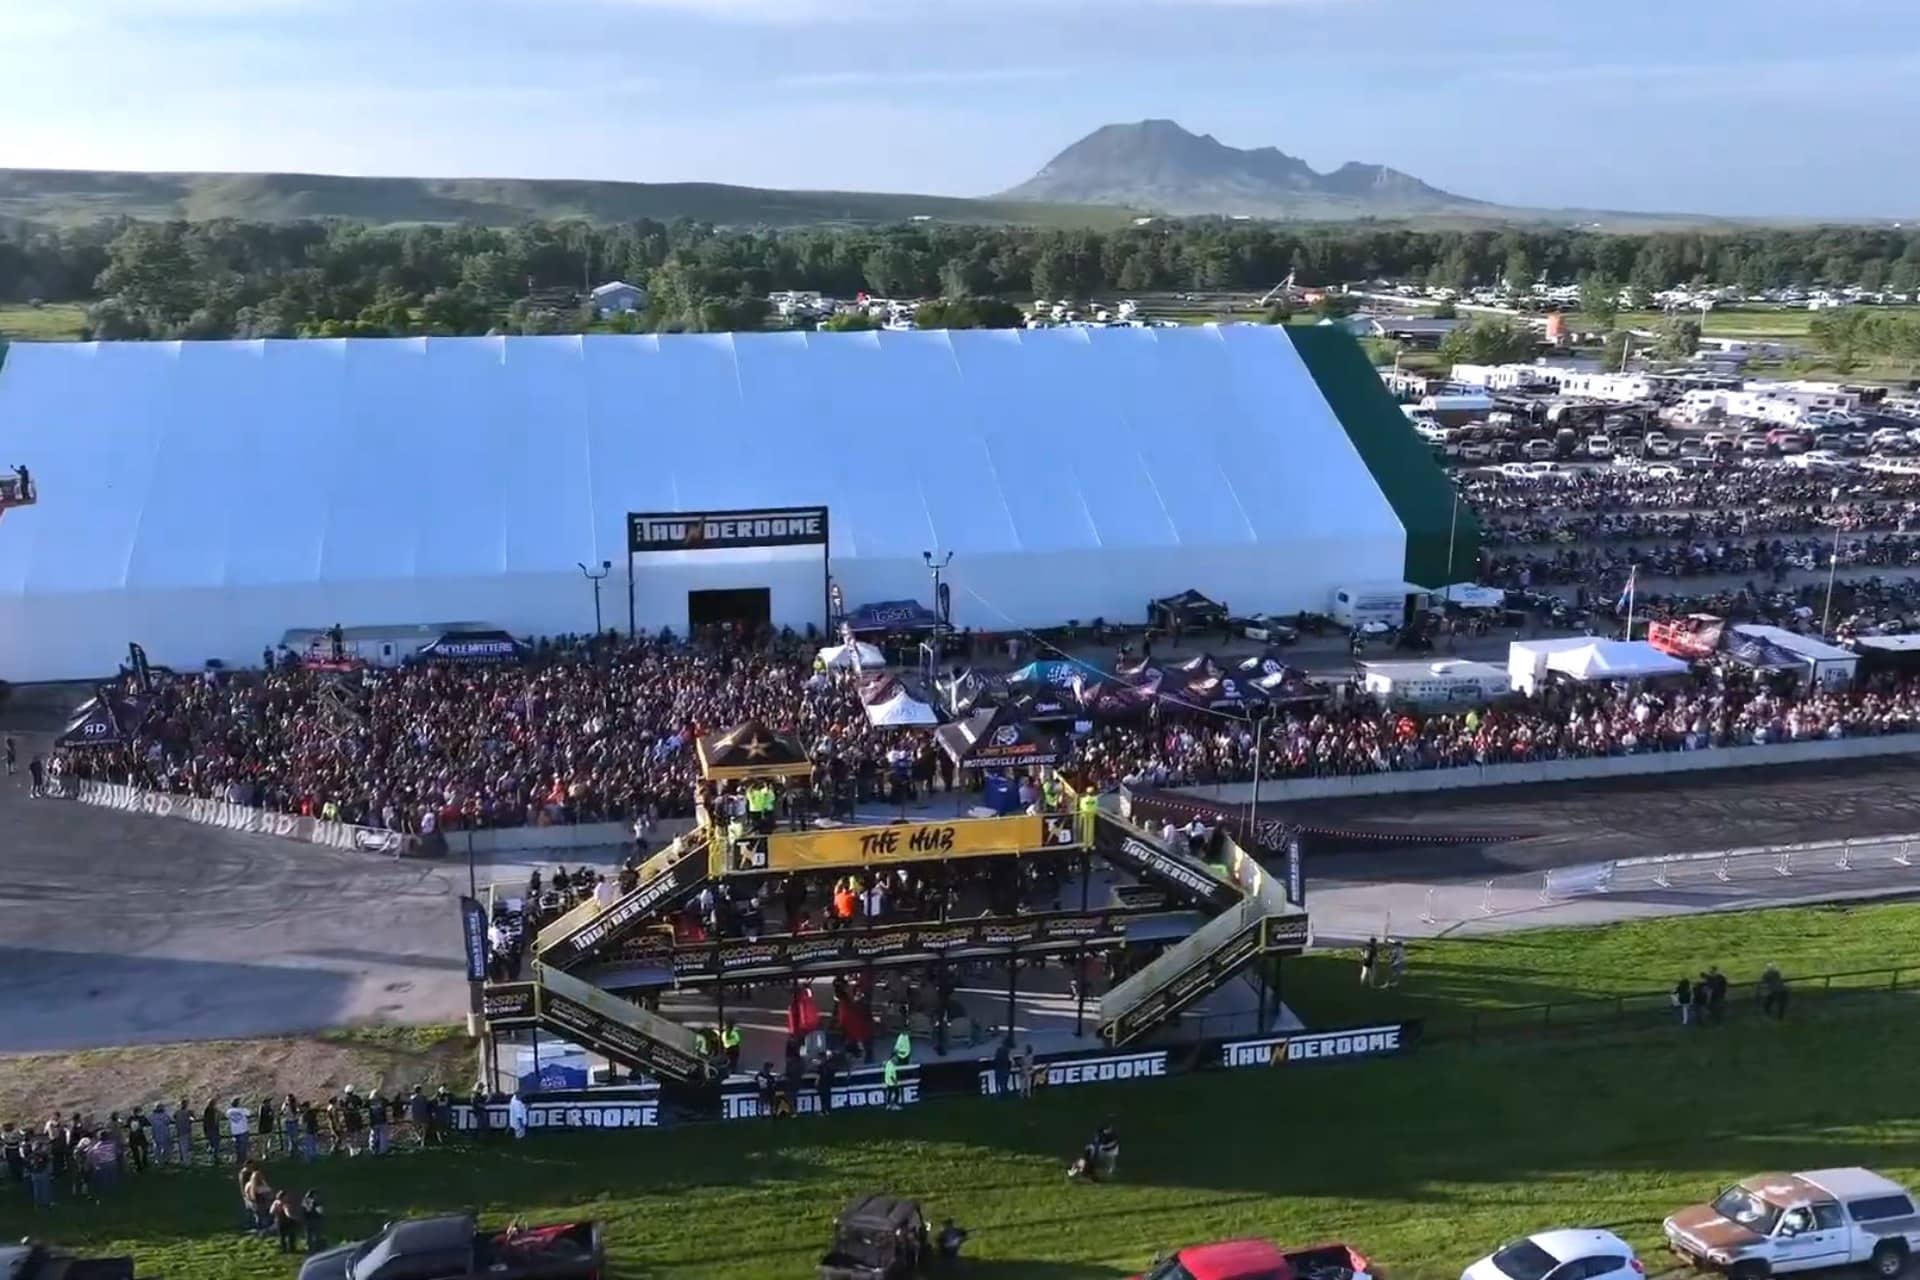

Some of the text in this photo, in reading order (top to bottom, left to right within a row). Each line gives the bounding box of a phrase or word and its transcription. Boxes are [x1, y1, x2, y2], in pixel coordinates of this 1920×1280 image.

[633, 511, 822, 542] THUNDERDOME
[963, 754, 1057, 767] MOTORCYCLE LAWYERS
[859, 827, 955, 857] THE HUB
[1122, 837, 1218, 897] THUNDERDOME
[570, 872, 679, 951] THUNDERDOME
[1222, 1025, 1401, 1067] THUNDERDOME
